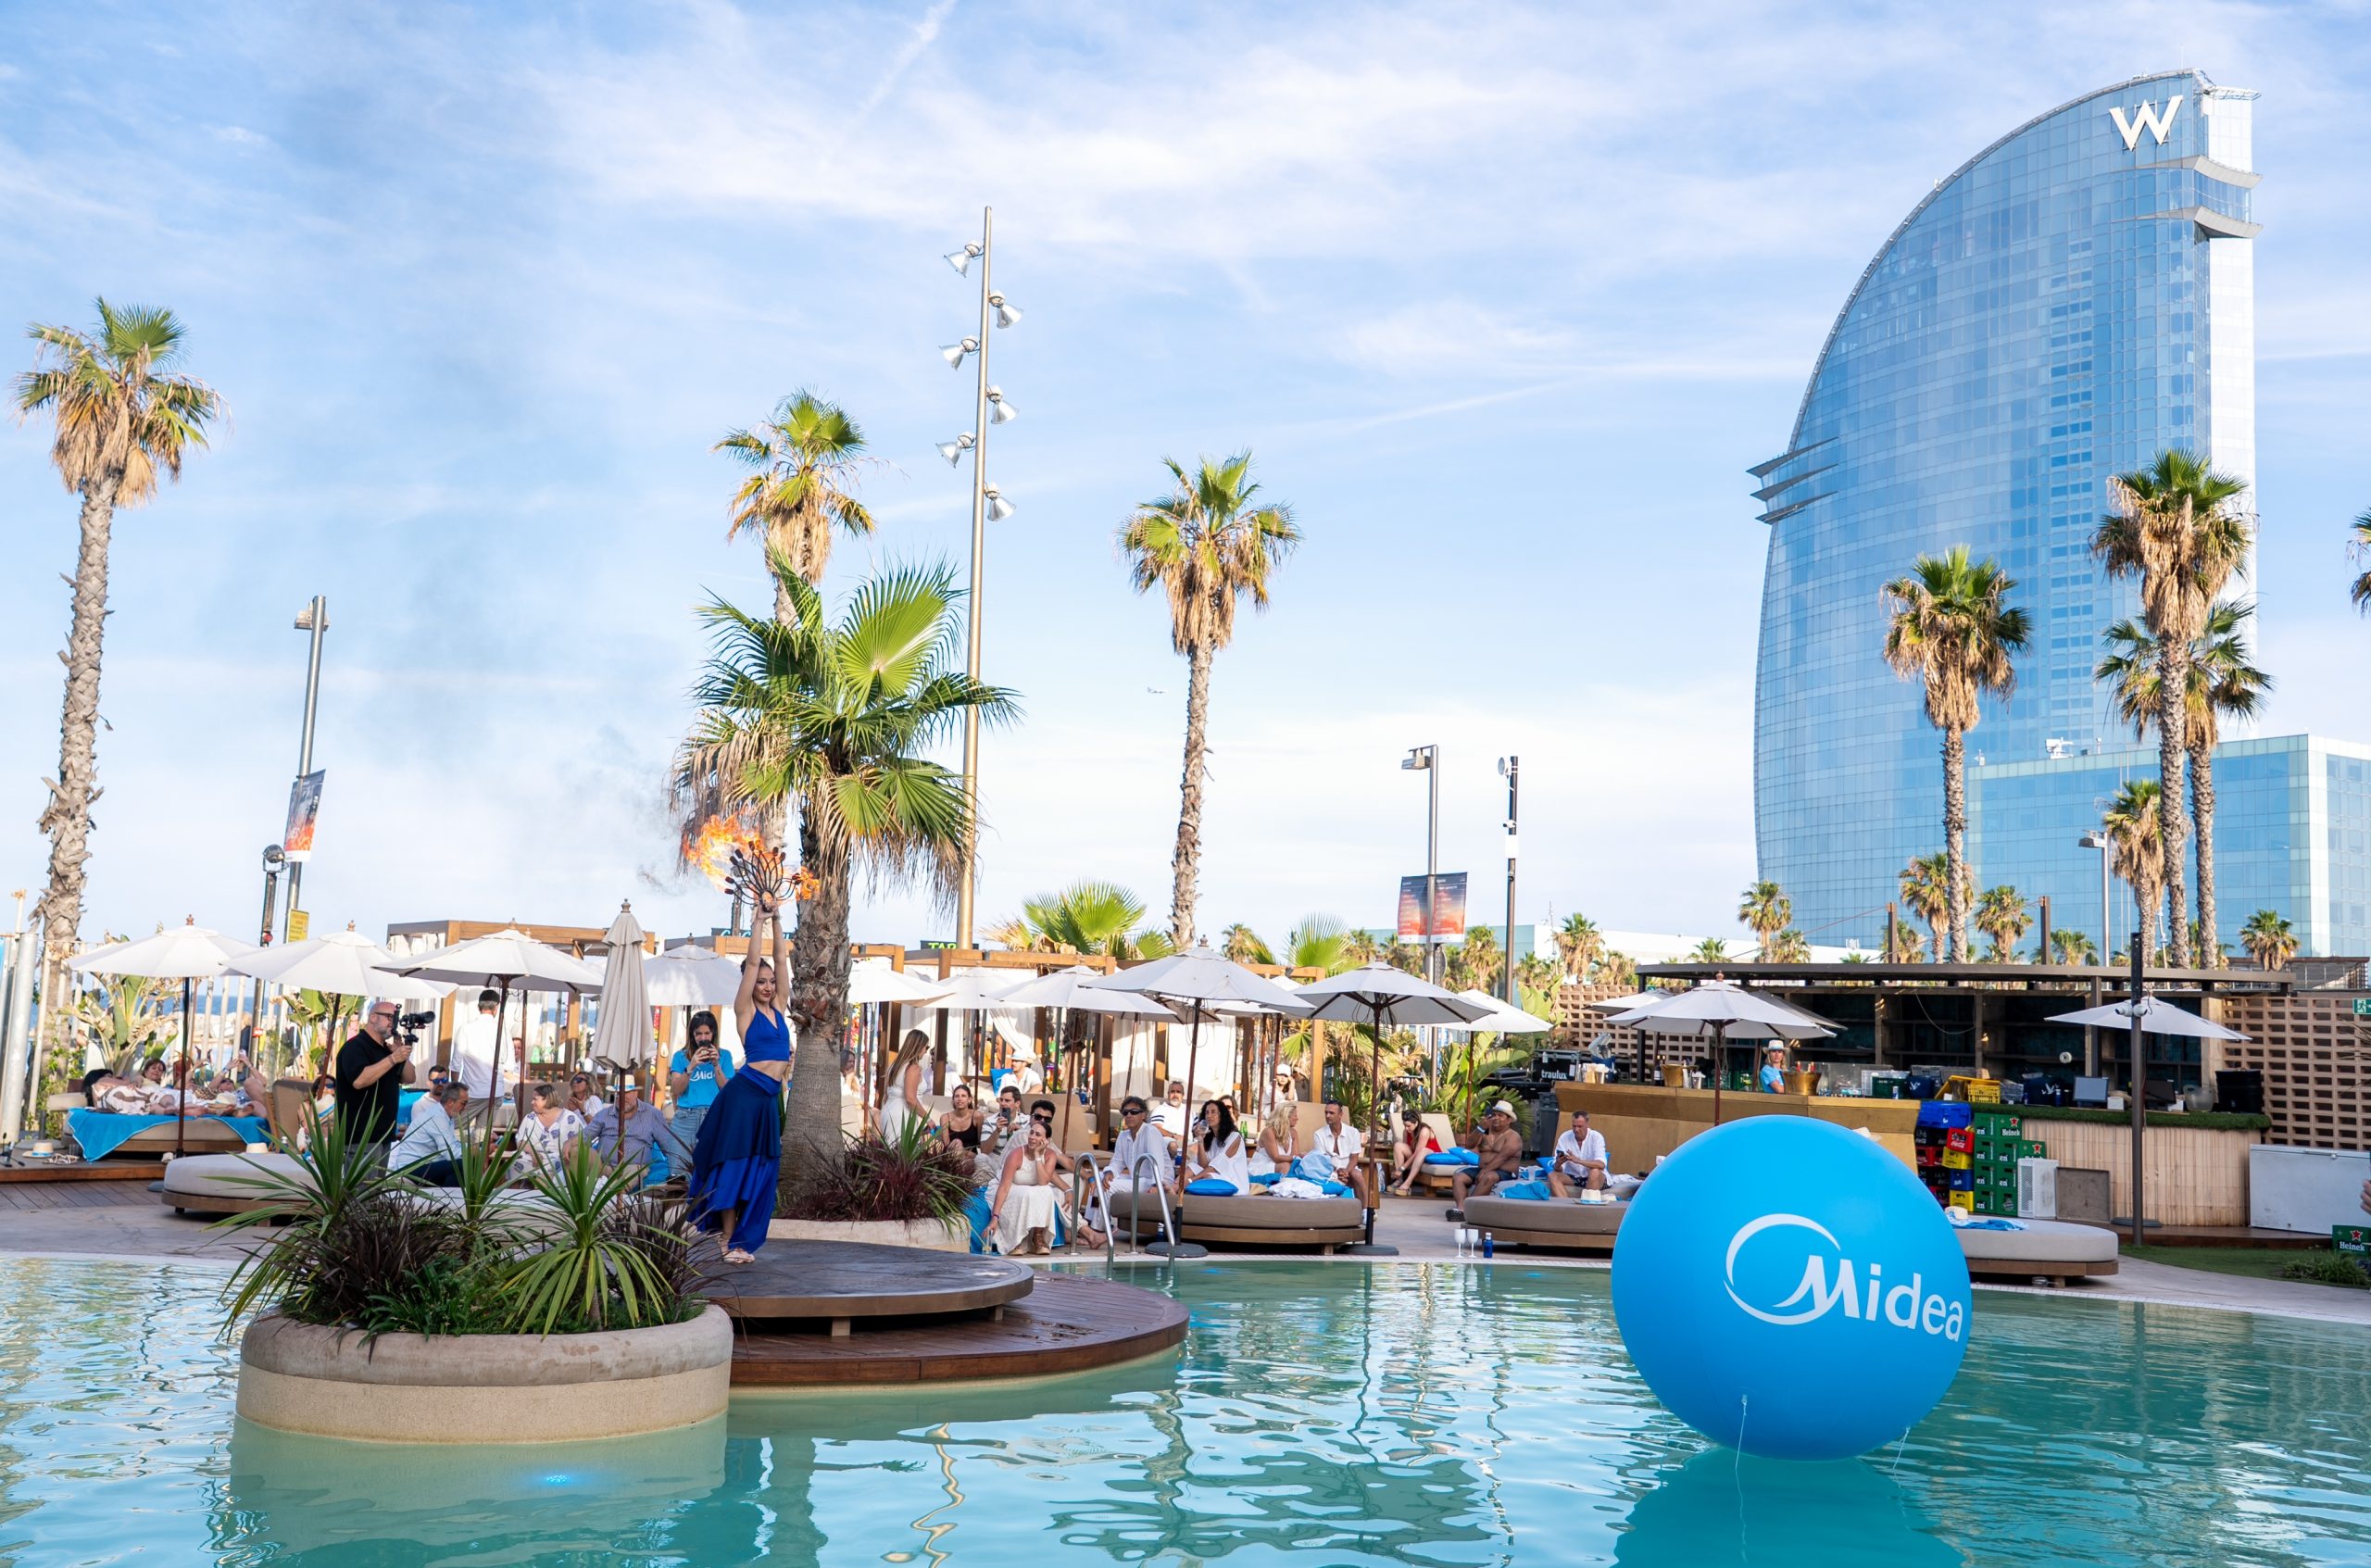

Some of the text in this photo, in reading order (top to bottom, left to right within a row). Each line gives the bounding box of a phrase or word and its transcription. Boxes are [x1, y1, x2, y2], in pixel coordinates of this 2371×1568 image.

[2108, 94, 2184, 152] W
[1541, 1070, 1567, 1080] traulux
[1724, 1254, 1963, 1343] Midea
